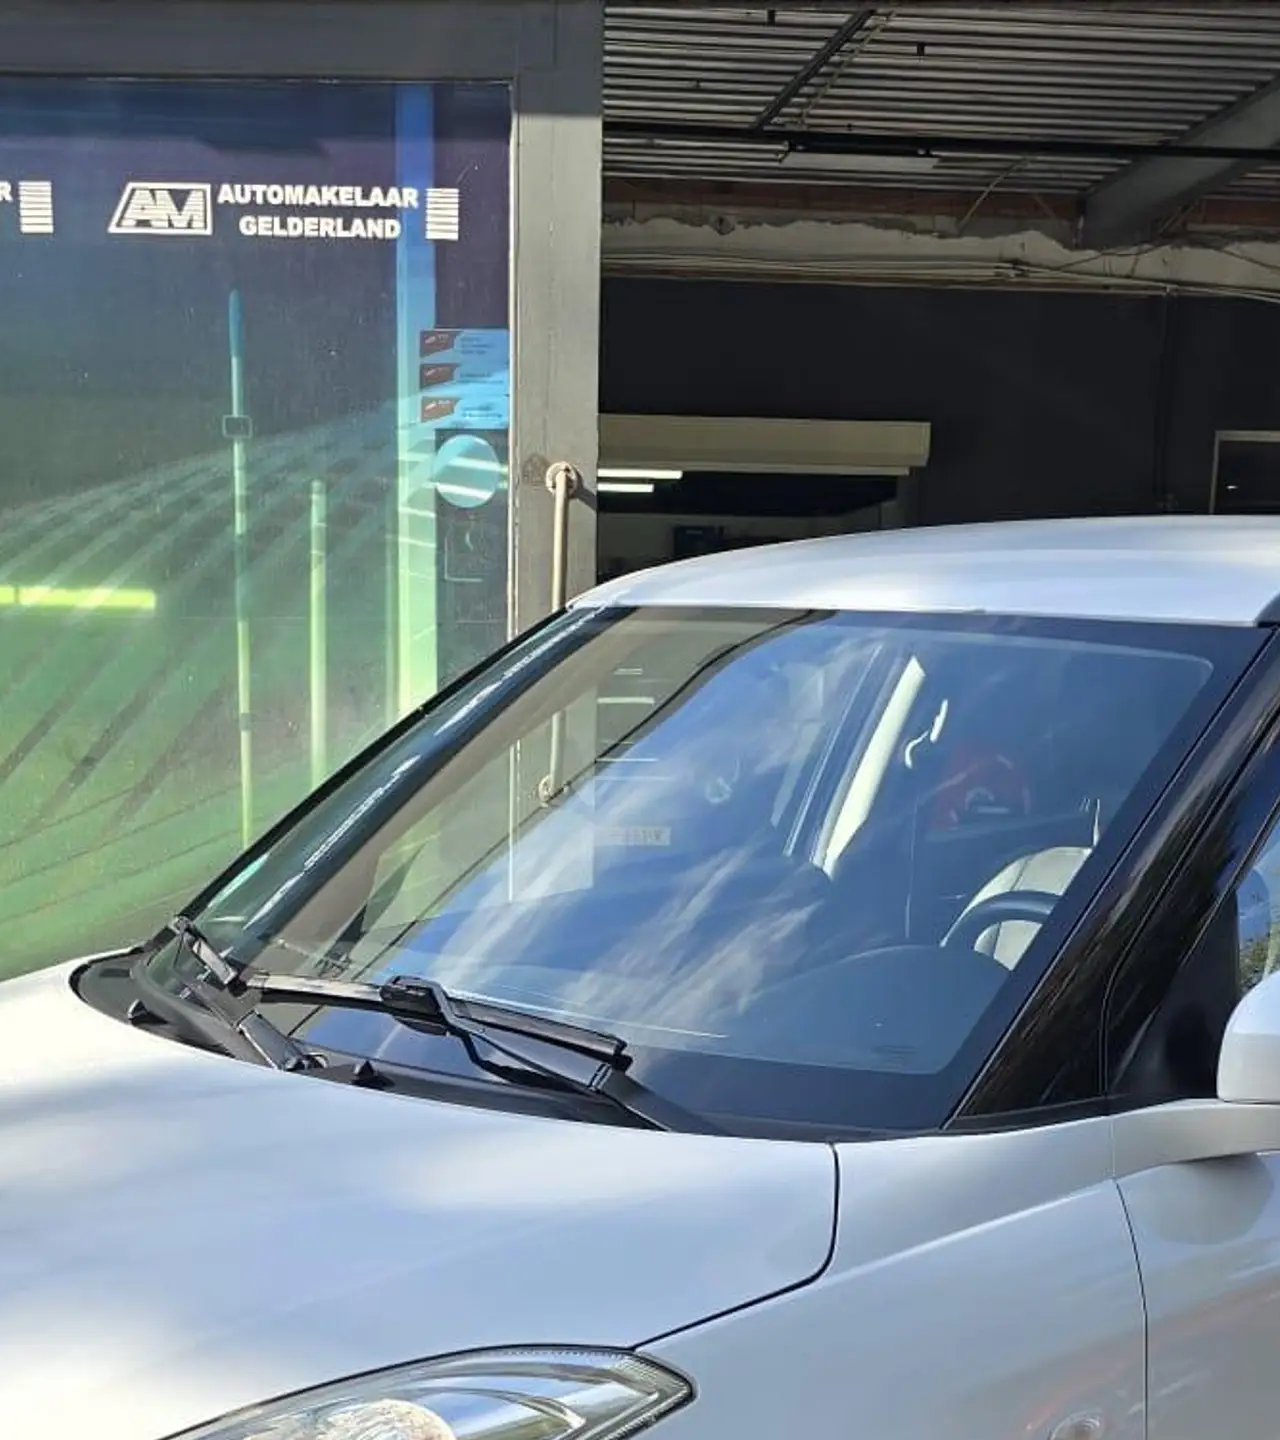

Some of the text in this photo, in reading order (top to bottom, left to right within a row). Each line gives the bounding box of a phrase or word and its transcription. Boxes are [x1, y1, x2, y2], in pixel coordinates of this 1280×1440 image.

[120, 188, 204, 228] AM
[217, 183, 419, 208] AUTOMAKELAAR
[238, 215, 401, 239] GELDERLAND
